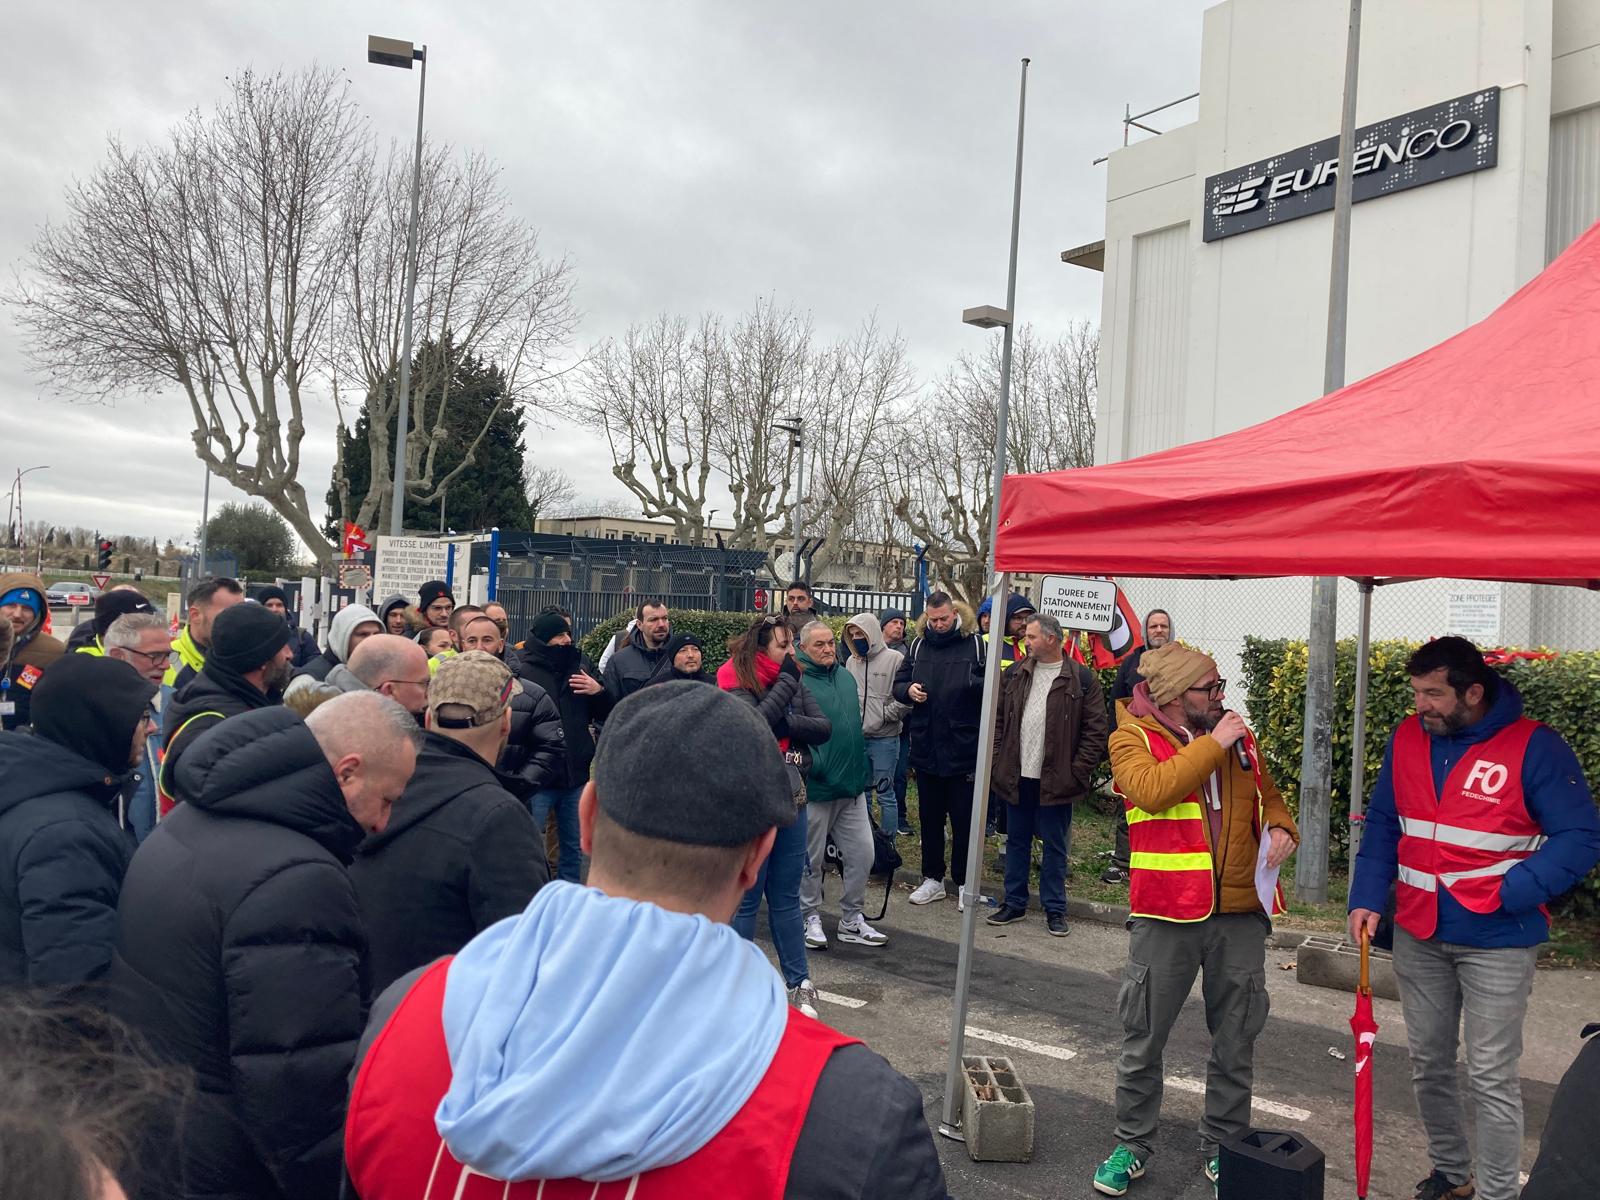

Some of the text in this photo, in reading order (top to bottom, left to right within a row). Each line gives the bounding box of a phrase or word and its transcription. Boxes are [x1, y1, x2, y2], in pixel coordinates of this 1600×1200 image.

[1268, 119, 1472, 199] EURENCO
[389, 539, 417, 549] VITESSE
[1058, 588, 1099, 598] DUREE DE
[1043, 597, 1112, 612] STATIONNEMENT
[1043, 608, 1074, 618] LIMITEE
[1092, 614, 1110, 622] MIN
[1463, 759, 1508, 795] FO
[1461, 790, 1502, 804] FEDECHIMIE
